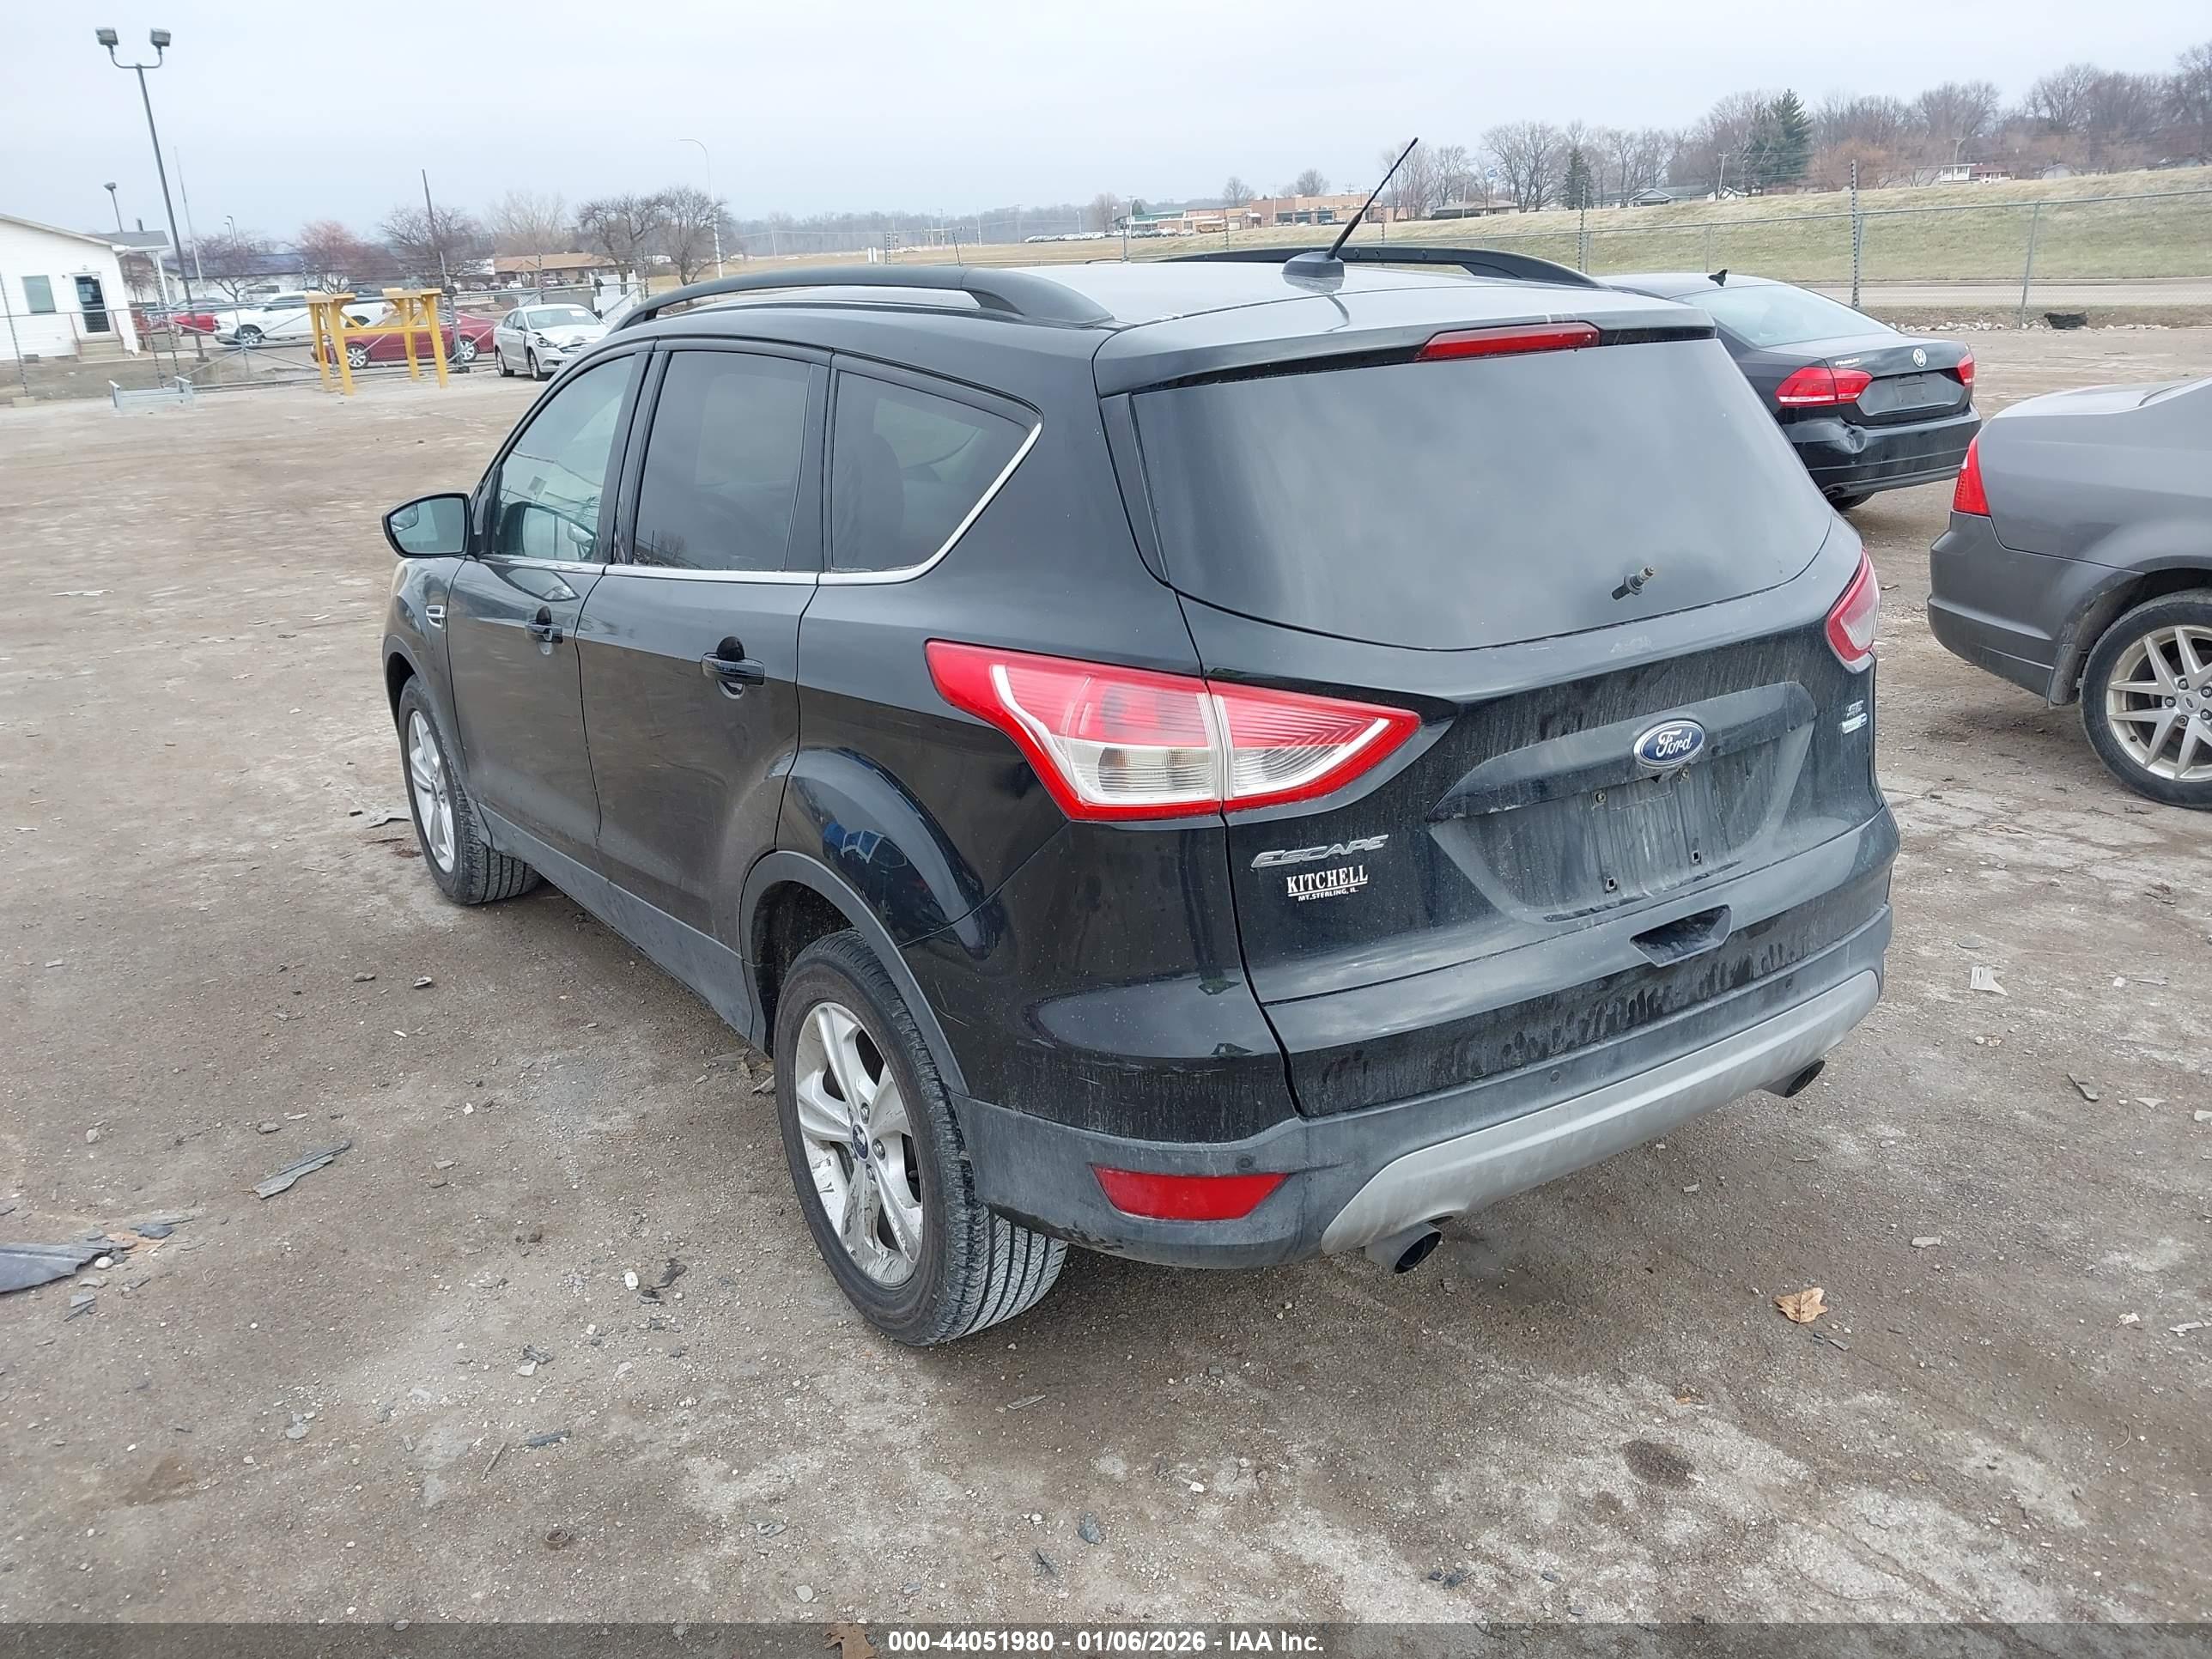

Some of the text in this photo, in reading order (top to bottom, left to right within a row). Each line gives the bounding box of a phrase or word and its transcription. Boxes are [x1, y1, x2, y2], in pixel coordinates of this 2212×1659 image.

[1656, 728, 1692, 757] Ford
[1250, 834, 1389, 869] ESCAPE
[1286, 865, 1369, 894] KITCHELL
